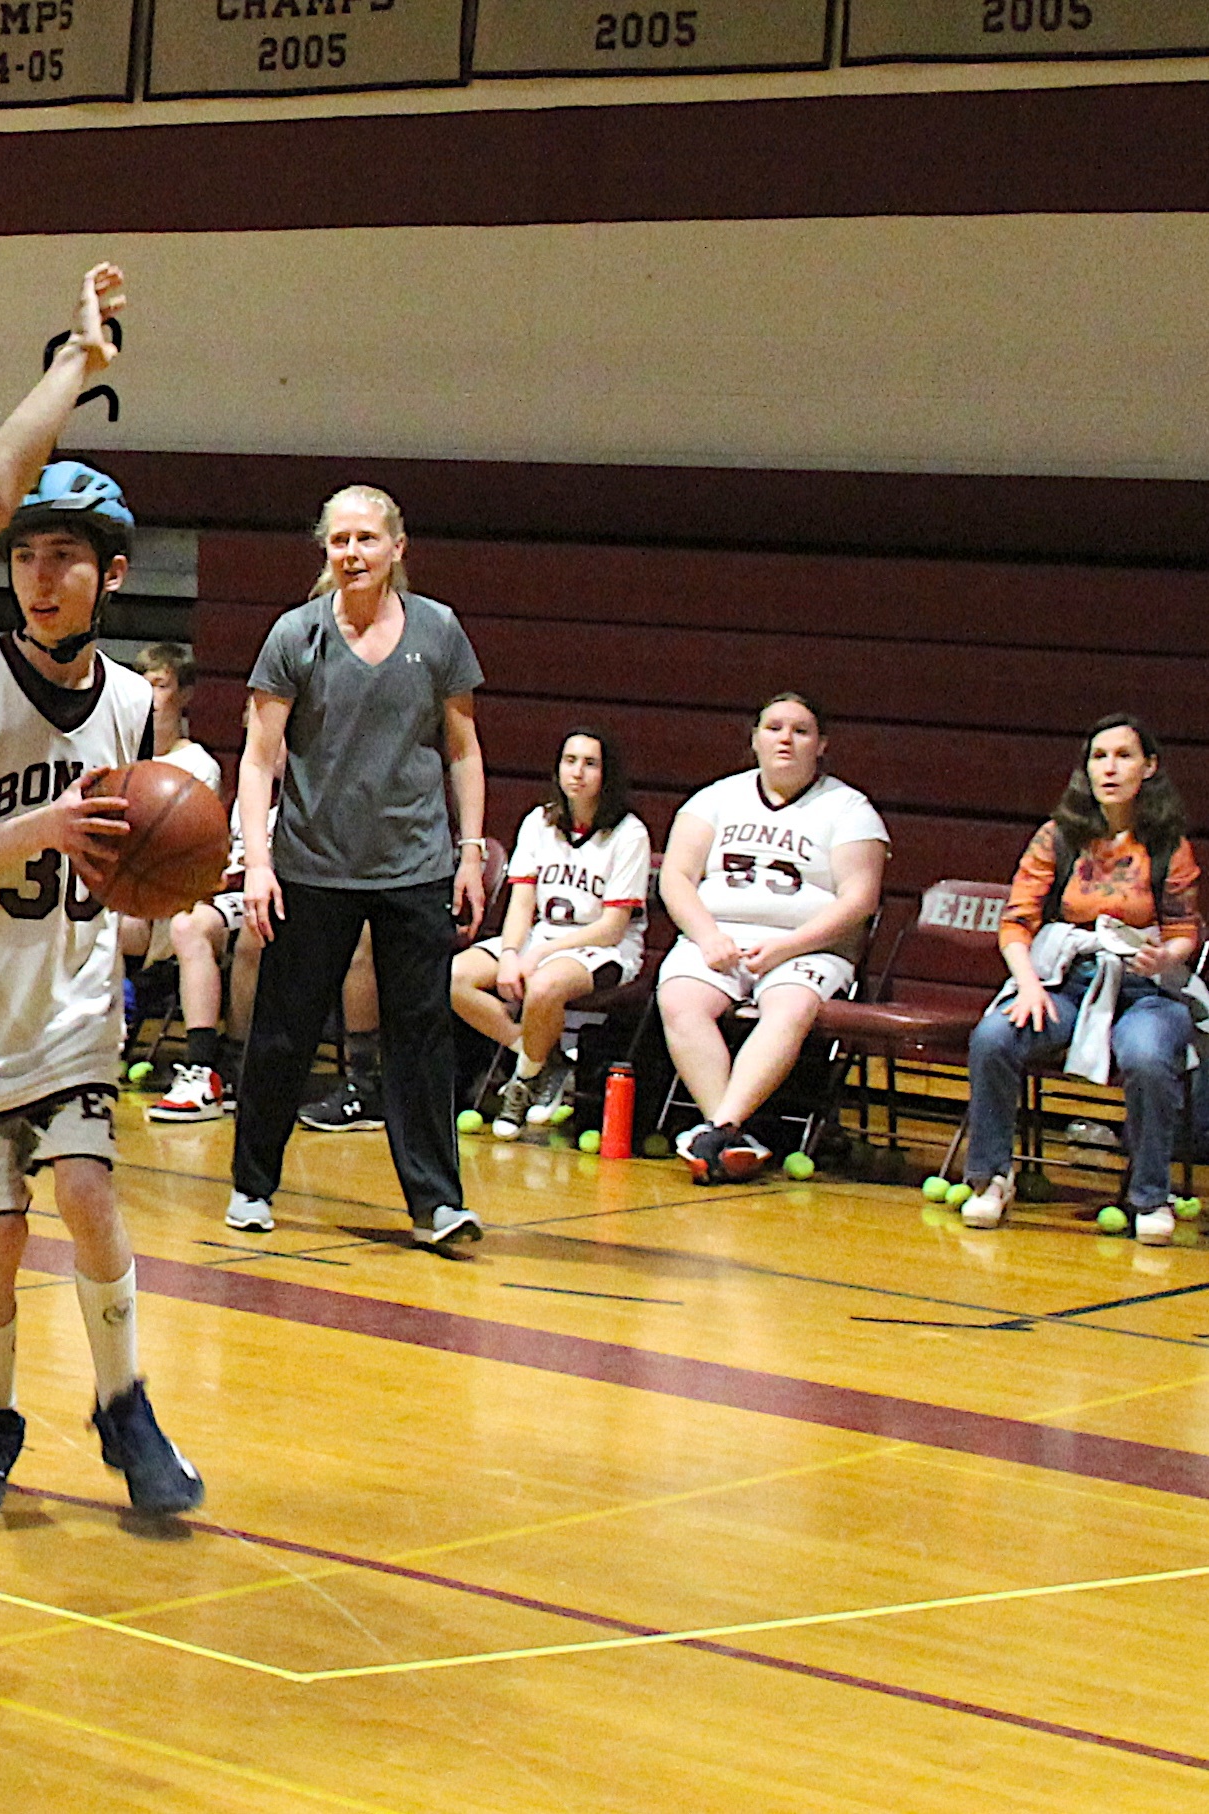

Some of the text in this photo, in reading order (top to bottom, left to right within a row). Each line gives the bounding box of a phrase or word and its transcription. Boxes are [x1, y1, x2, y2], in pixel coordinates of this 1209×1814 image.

[594, 10, 698, 50] 2005
[982, 0, 1093, 33] 2005
[258, 33, 347, 72] 2005
[719, 823, 814, 862] BONAC
[537, 863, 606, 899] ONAC
